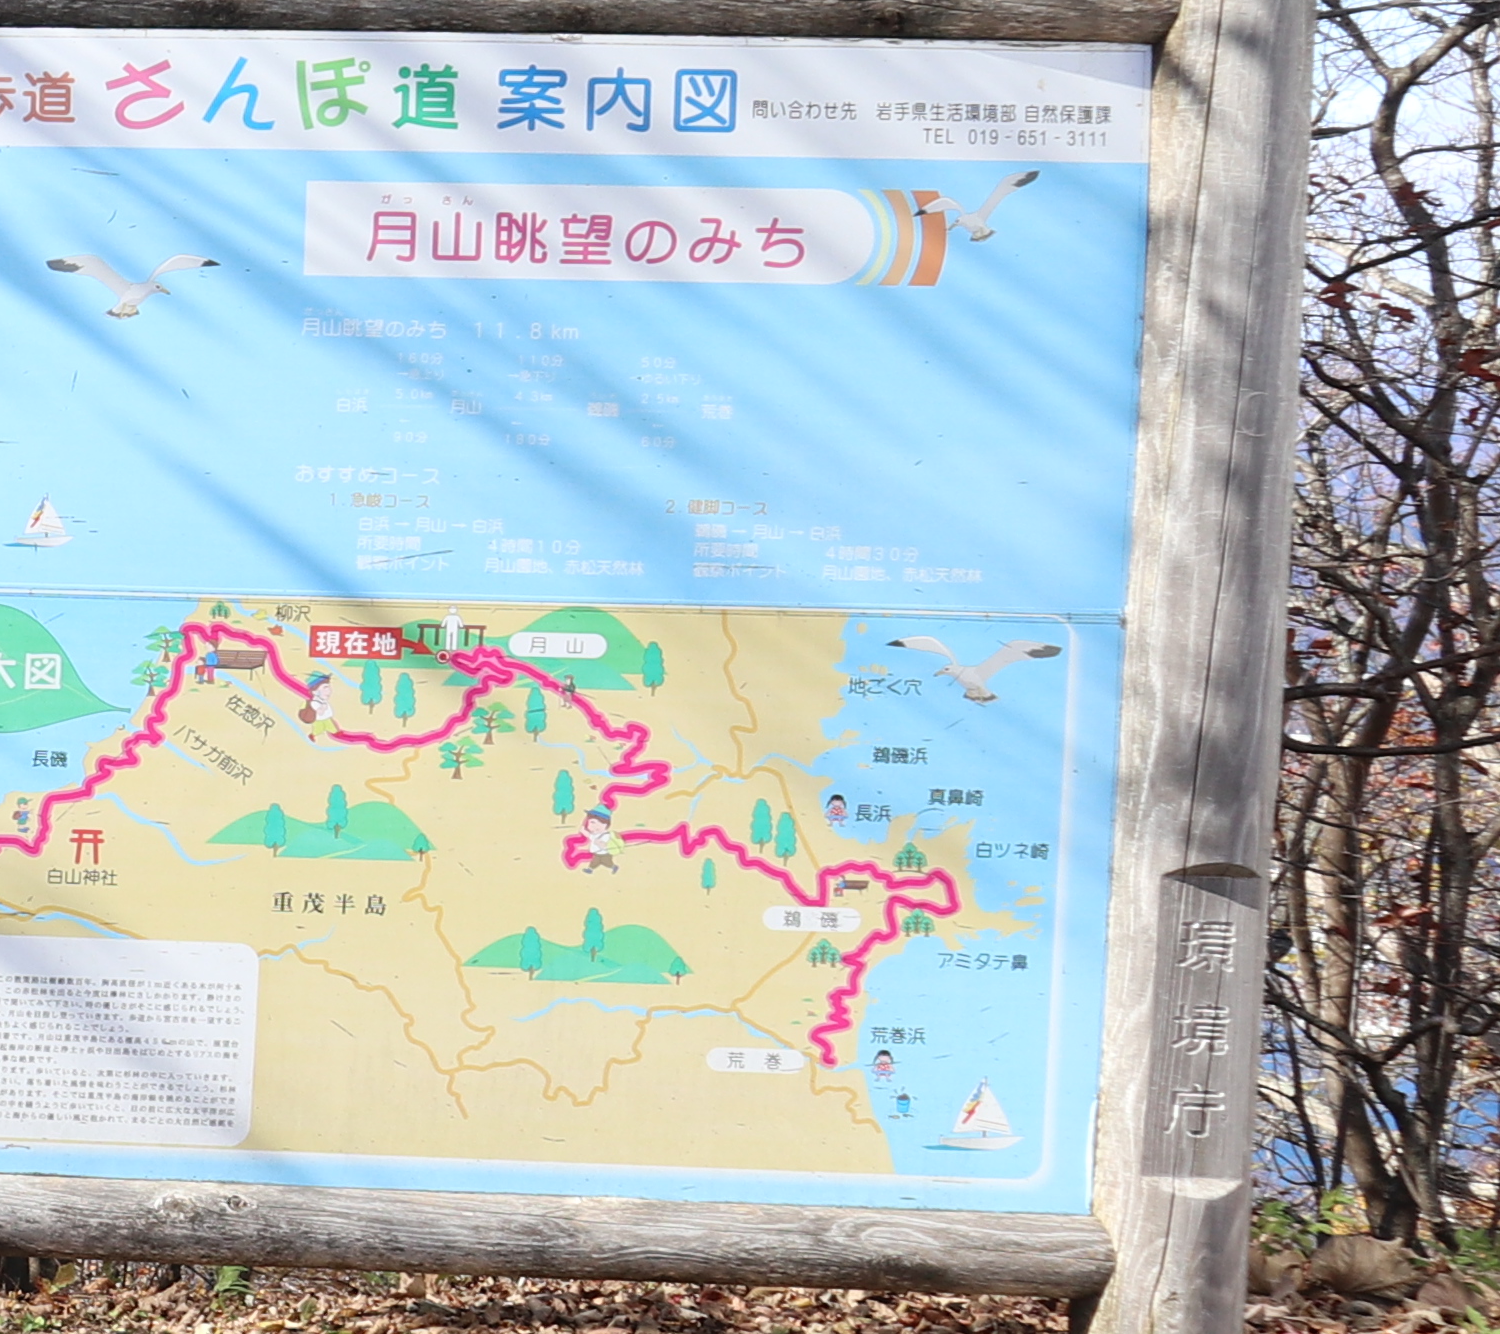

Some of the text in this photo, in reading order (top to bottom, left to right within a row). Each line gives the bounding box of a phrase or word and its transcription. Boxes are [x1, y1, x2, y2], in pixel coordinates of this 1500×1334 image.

[106, 57, 459, 131] さんぽ道
[496, 65, 736, 133] 案内図
[752, 100, 1112, 125] 問い合わせ先 岩手県生活環境部 自然保護課
[923, 128, 955, 145] TEL
[366, 210, 806, 269] 月山眺望のみち
[301, 317, 447, 339] 月山眺望のみち
[294, 466, 441, 485] おすすめコース
[358, 517, 504, 534] 白浜 月山 白浜
[275, 604, 311, 622] 柳沢
[316, 631, 397, 656] 現在地
[528, 637, 584, 655] 月山
[848, 677, 922, 696] 地ごく穴
[32, 750, 68, 767] 長磯
[927, 788, 984, 807] 真鼻崎
[855, 804, 892, 822] 長浜
[975, 841, 1050, 860] 白ツネ崎
[47, 868, 118, 887] 白山神社
[272, 892, 387, 917] 重茂半島
[937, 951, 1028, 971] アミタテ鼻
[870, 1026, 926, 1046] 荒巻浜
[1163, 920, 1237, 1139] 環境庁
[727, 1051, 782, 1070] 荒巻
